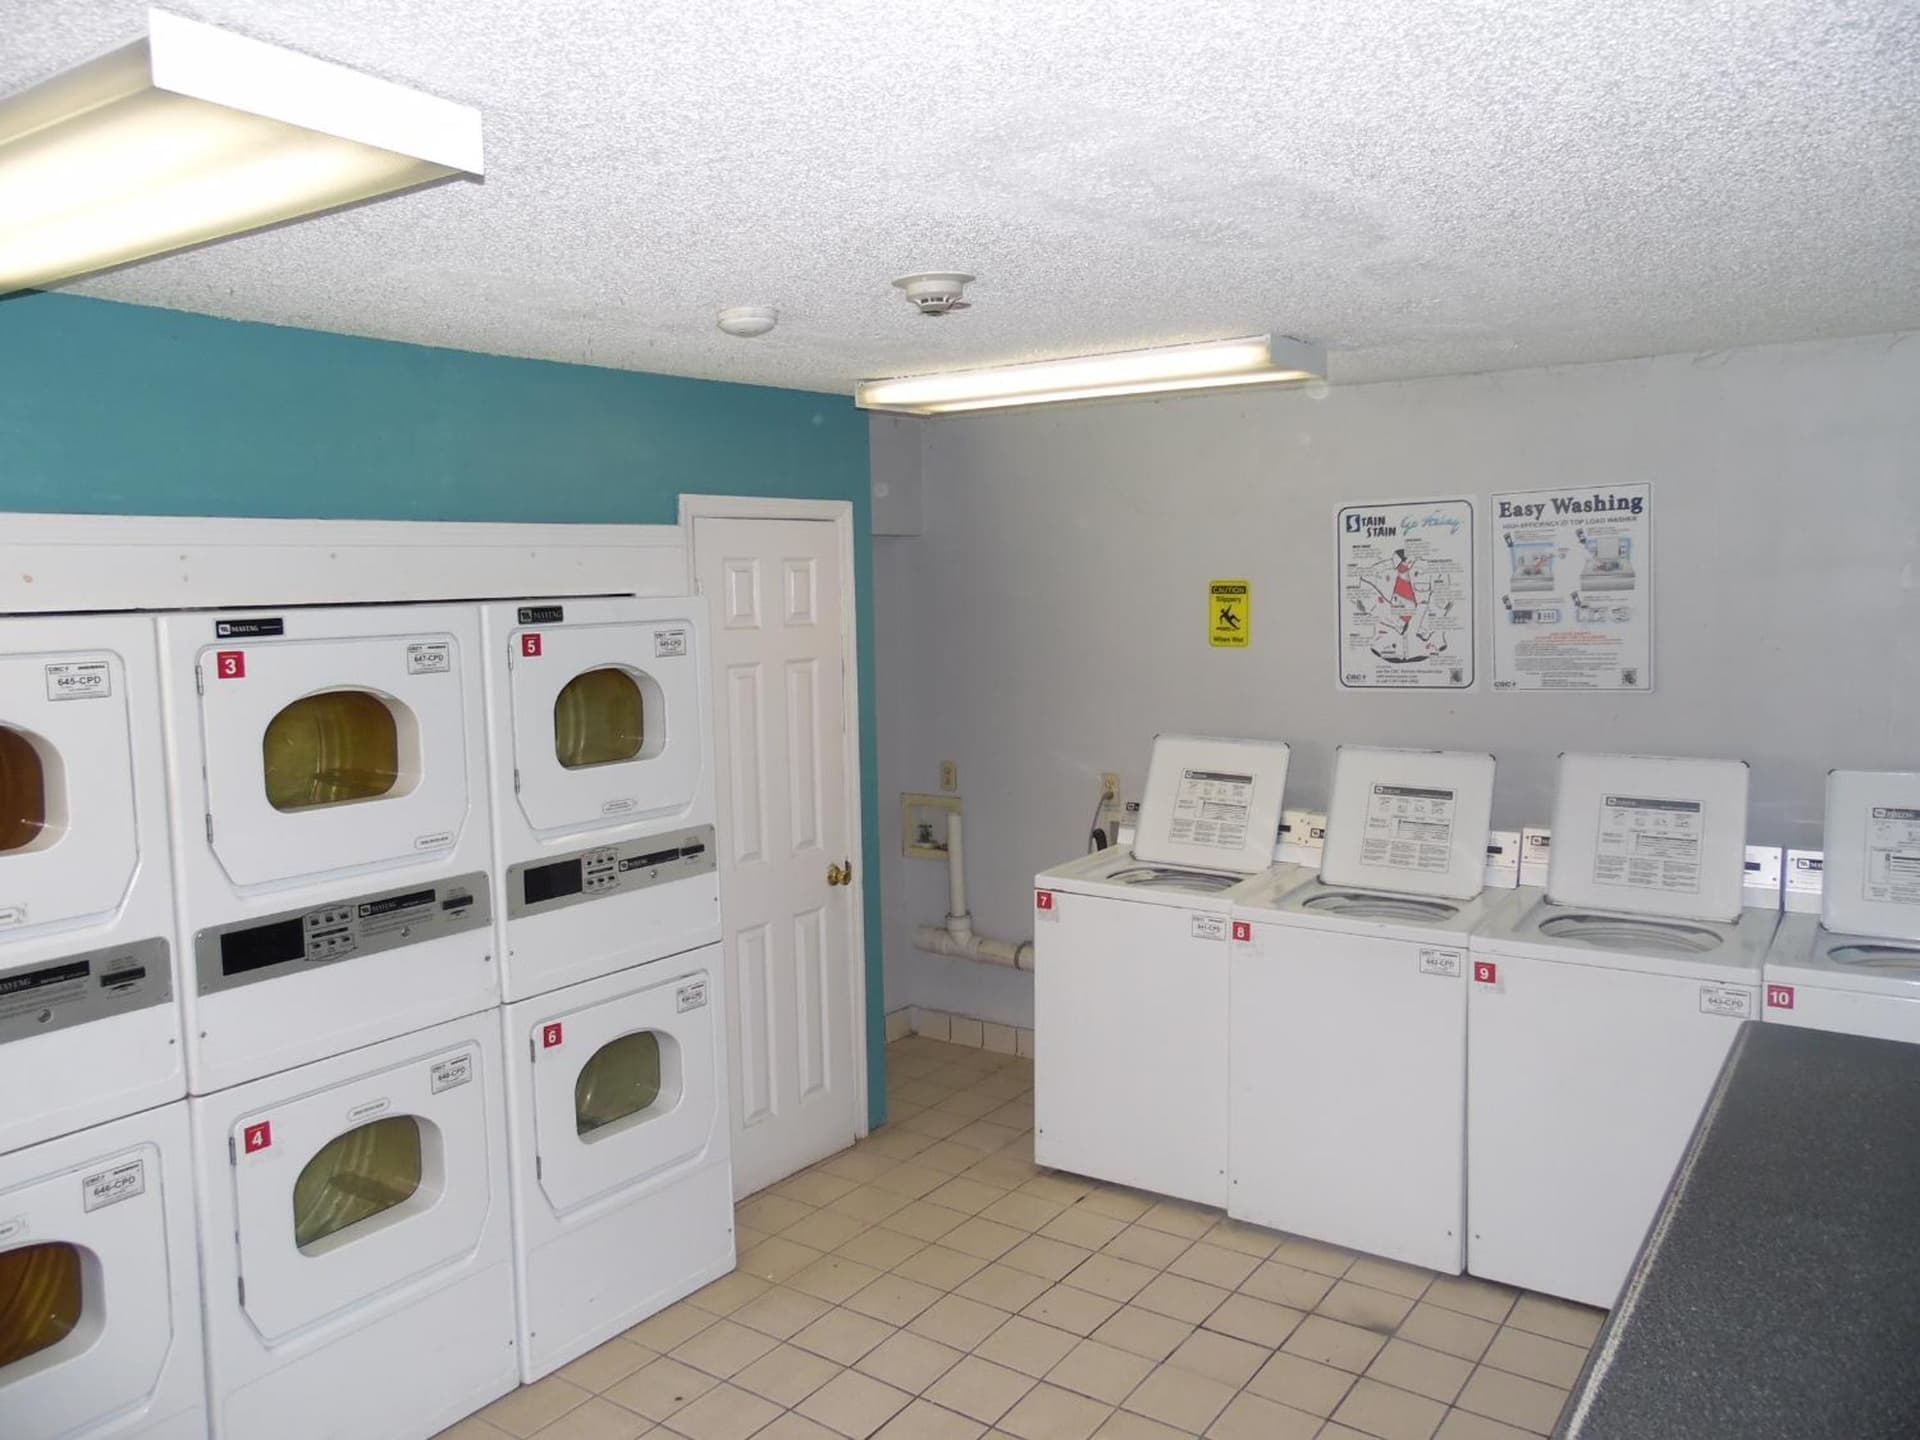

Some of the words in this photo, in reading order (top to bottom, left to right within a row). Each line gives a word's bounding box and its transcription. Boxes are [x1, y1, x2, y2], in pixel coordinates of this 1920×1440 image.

[1499, 501, 1545, 520] Easy
[1551, 494, 1644, 514] Washing
[1607, 516, 1637, 524] WASHER
[1366, 527, 1397, 538] STAIN
[1212, 586, 1246, 594] CAUTION
[527, 639, 536, 654] 5
[224, 658, 237, 675] 3
[57, 675, 102, 687] 645-CPD
[1040, 895, 1048, 907] 7
[1237, 926, 1245, 938] 8
[1479, 967, 1489, 980] 9
[1770, 991, 1790, 1006] 10
[548, 1030, 557, 1044] 6
[251, 1130, 264, 1146] 4
